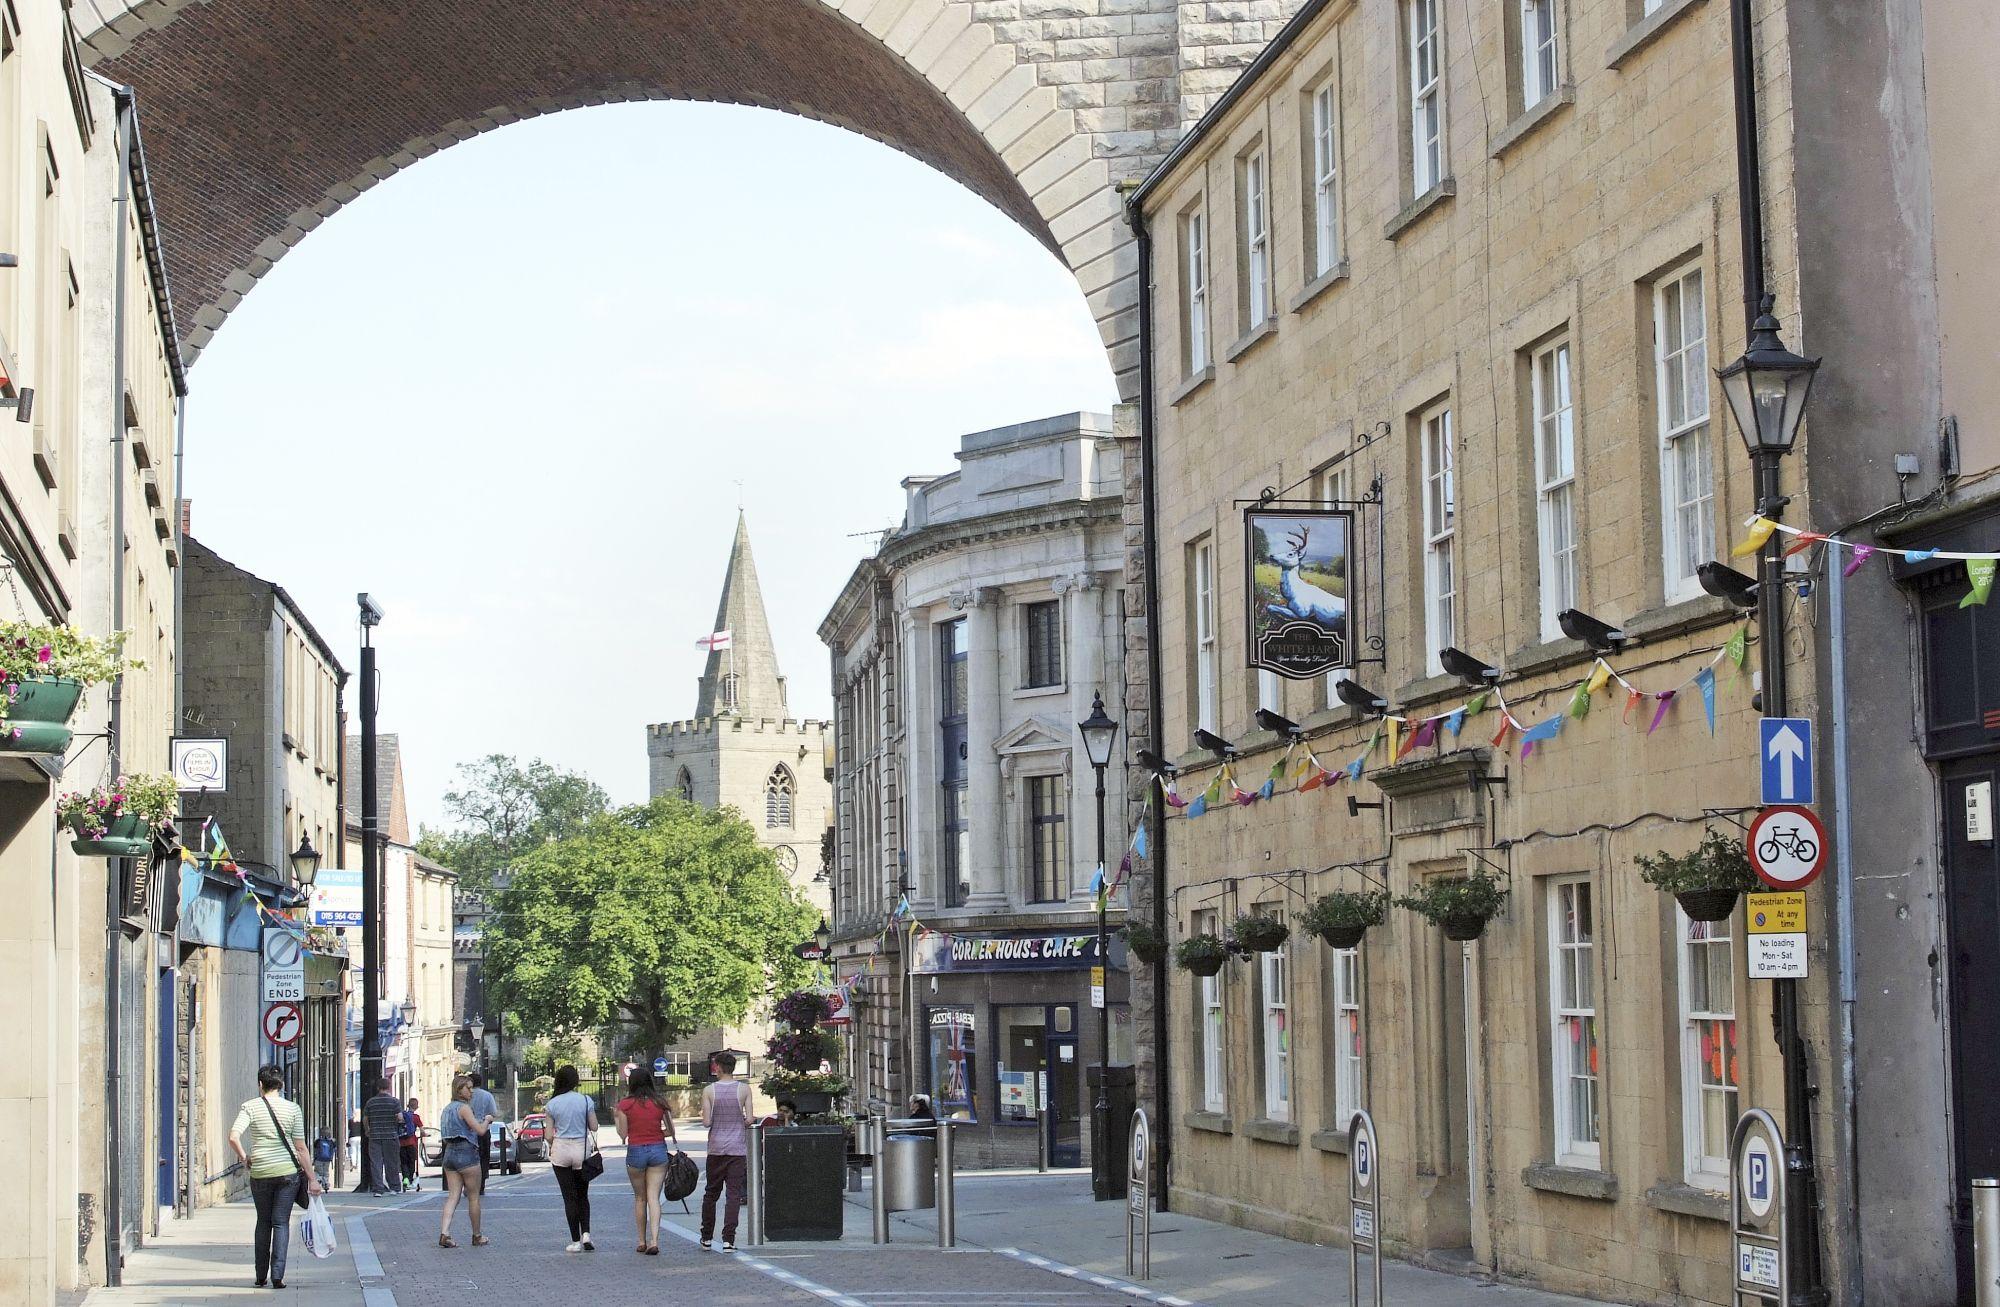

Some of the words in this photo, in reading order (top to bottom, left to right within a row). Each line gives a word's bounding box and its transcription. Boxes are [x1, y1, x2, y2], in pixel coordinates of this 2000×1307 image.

[1268, 644, 1305, 654] WHITE
[1308, 645, 1339, 655] HART
[1750, 897, 1784, 906] Pedestrian
[1787, 897, 1802, 905] Zone
[1777, 910, 1784, 918] At
[1787, 911, 1798, 919] any
[1781, 920, 1795, 928] time
[1771, 939, 1794, 948] loading
[1762, 952, 1776, 960] Mon
[1781, 951, 1792, 960] Sat
[269, 989, 299, 998] ENDS
[1752, 1158, 1764, 1194] P
